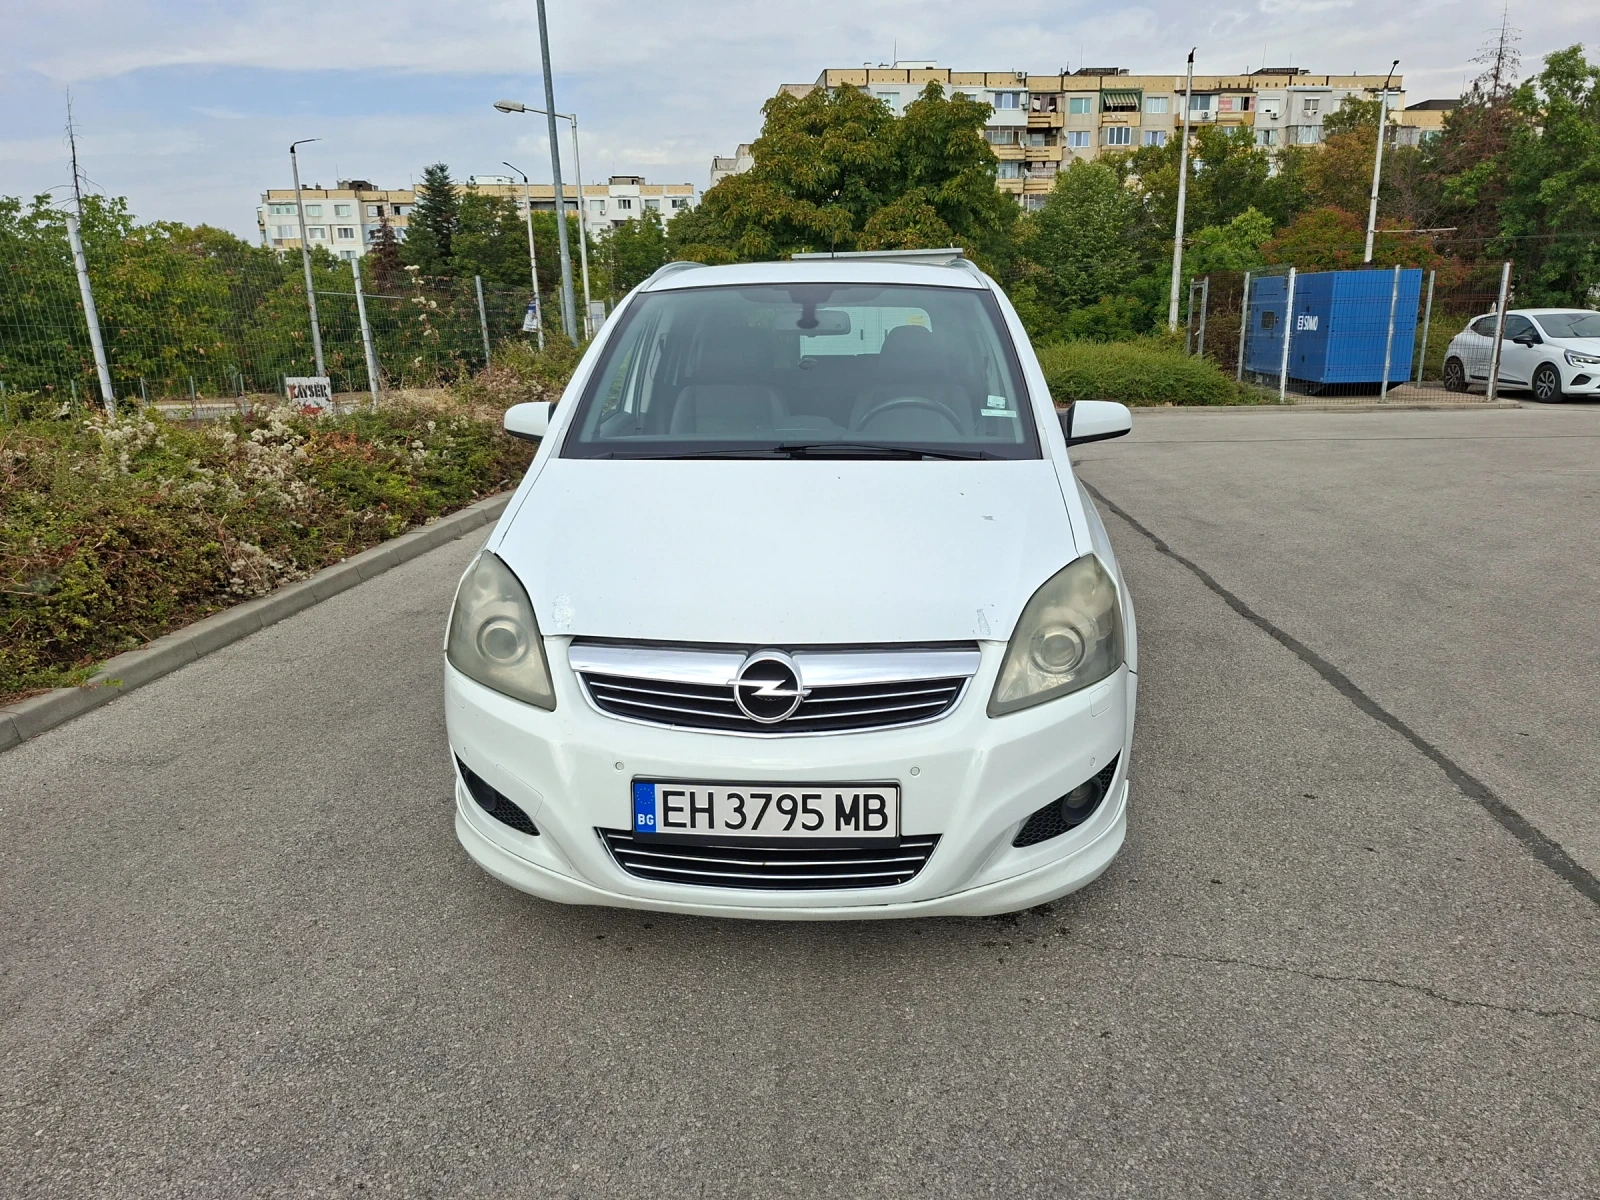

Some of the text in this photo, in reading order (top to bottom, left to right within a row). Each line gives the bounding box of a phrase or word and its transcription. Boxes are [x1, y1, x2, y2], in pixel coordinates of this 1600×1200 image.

[637, 813, 655, 826] BG
[662, 790, 889, 832] EH 3795 MB
